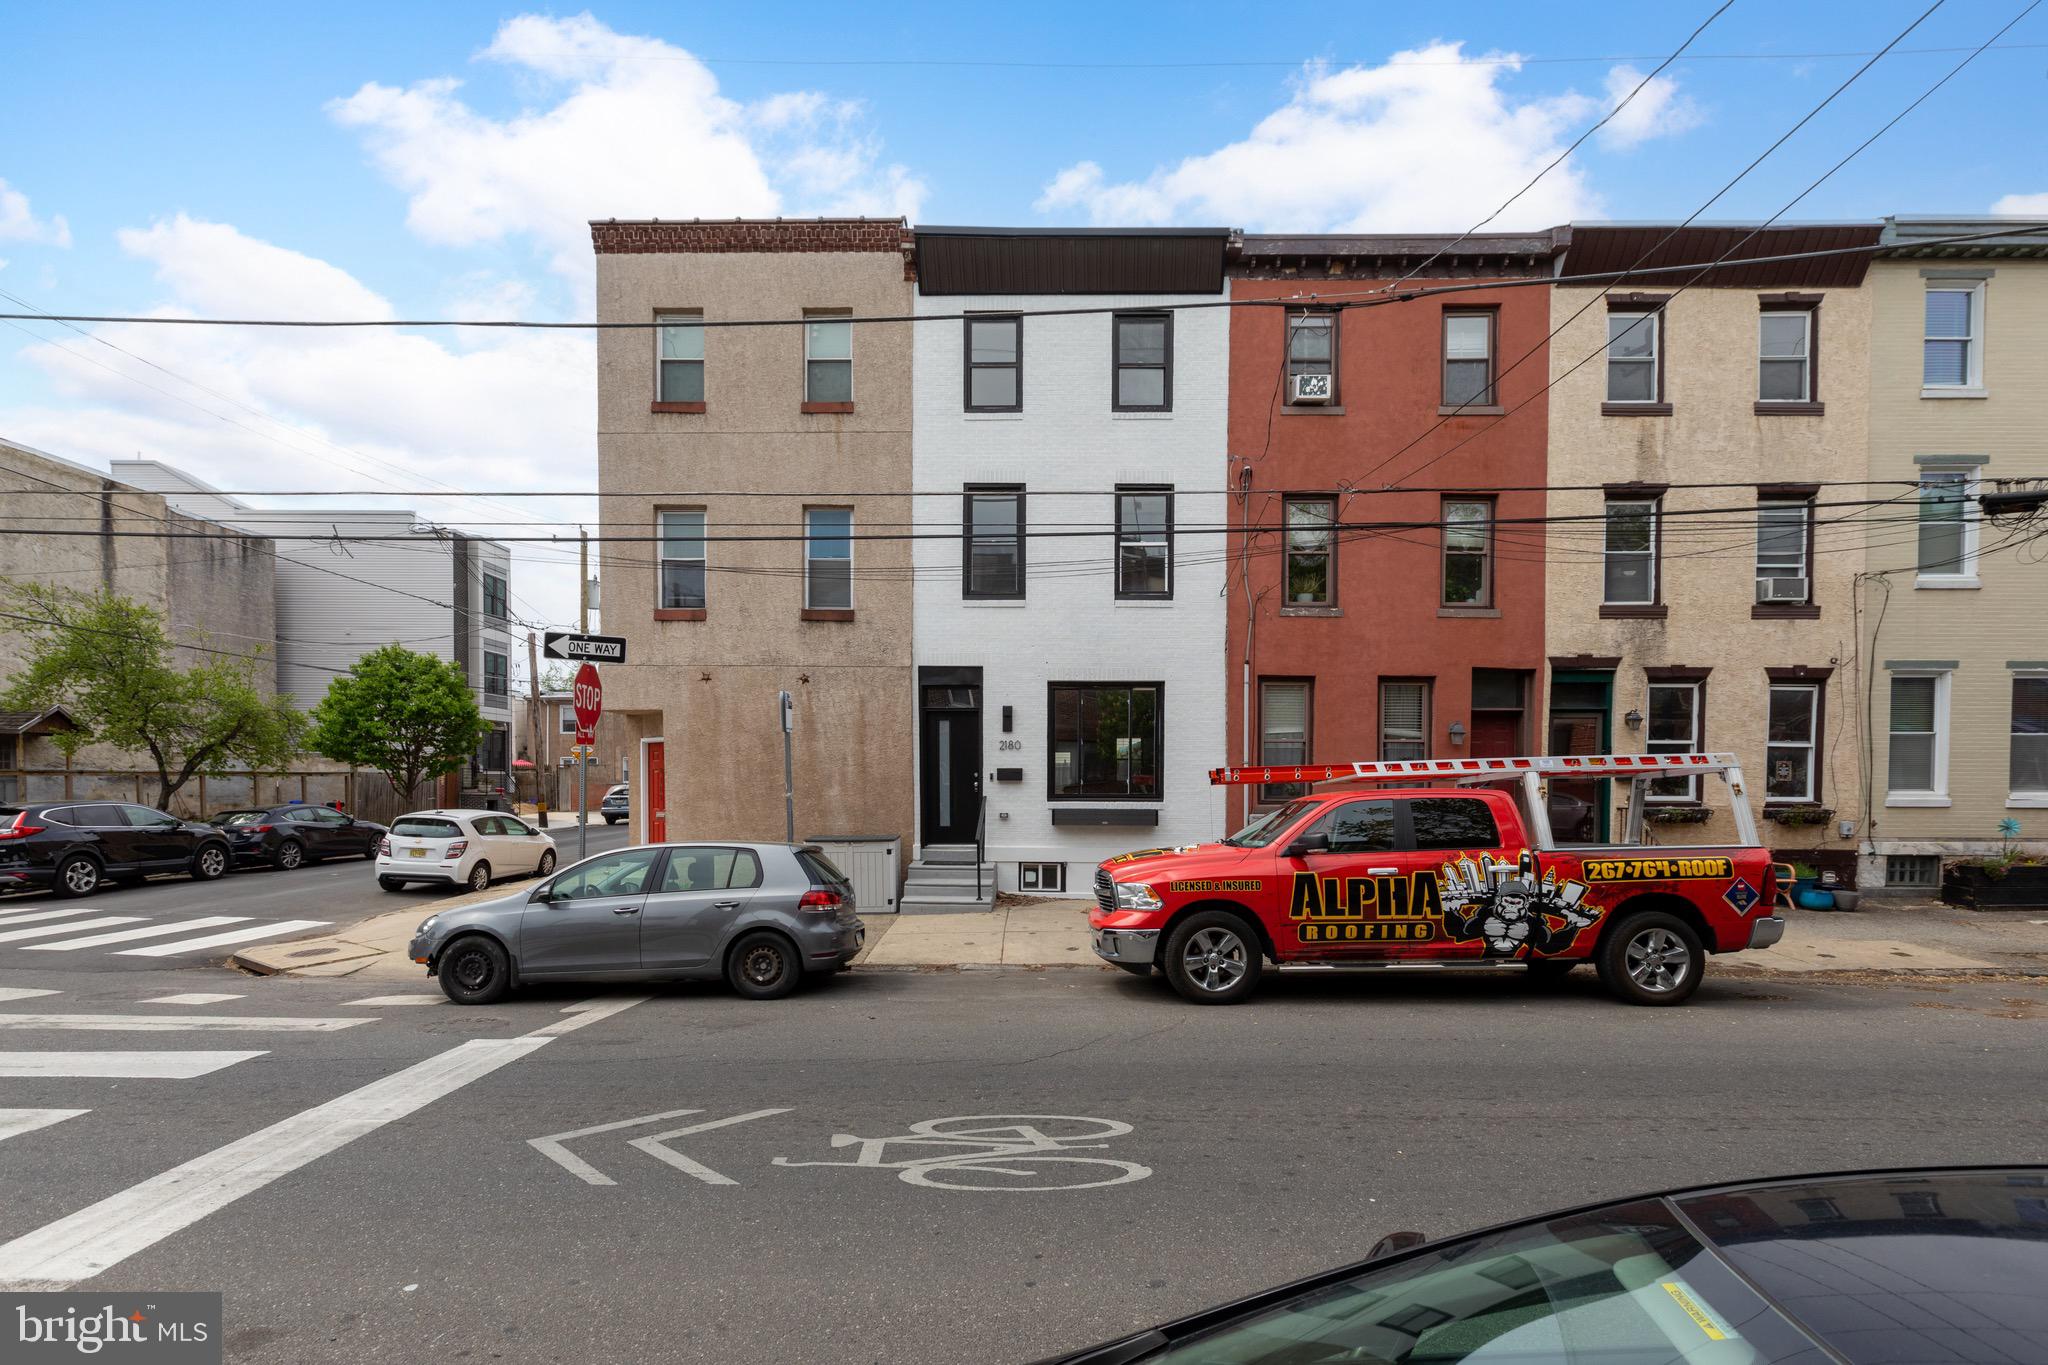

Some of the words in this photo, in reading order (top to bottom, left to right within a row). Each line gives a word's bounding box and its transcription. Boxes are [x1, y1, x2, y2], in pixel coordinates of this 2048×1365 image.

[568, 641, 591, 654] ONE
[594, 643, 618, 656] WAY
[575, 682, 601, 711] STOP
[999, 740, 1022, 751] 2180
[1170, 880, 1213, 892] LICENSED
[1214, 881, 1221, 891] &
[1222, 880, 1262, 892] INSURED
[1289, 871, 1444, 920] ALPHA
[1305, 924, 1428, 940] ROOFING
